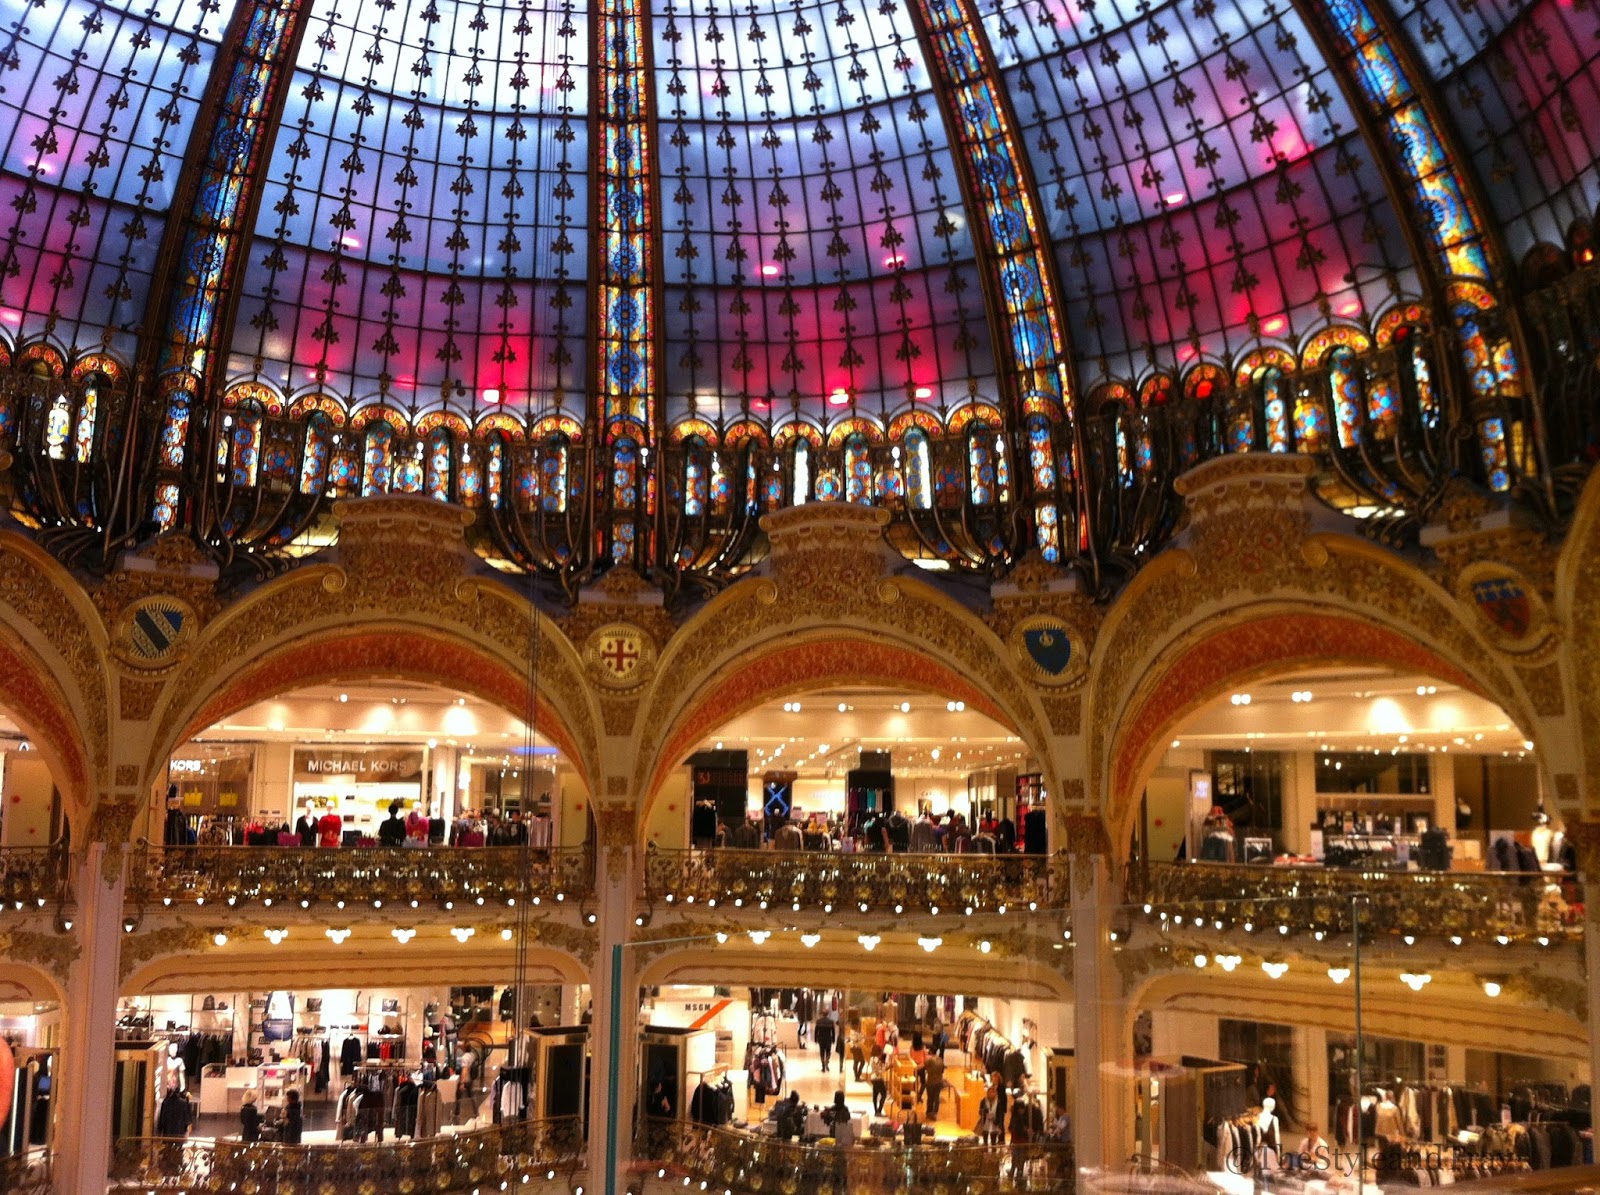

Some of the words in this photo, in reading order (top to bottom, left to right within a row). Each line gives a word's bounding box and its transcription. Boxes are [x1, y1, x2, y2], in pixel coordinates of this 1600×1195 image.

[171, 759, 201, 772] KORS
[308, 760, 366, 773] MICHAEL
[371, 760, 407, 773] KORS
[685, 1003, 711, 1011] MSGM
